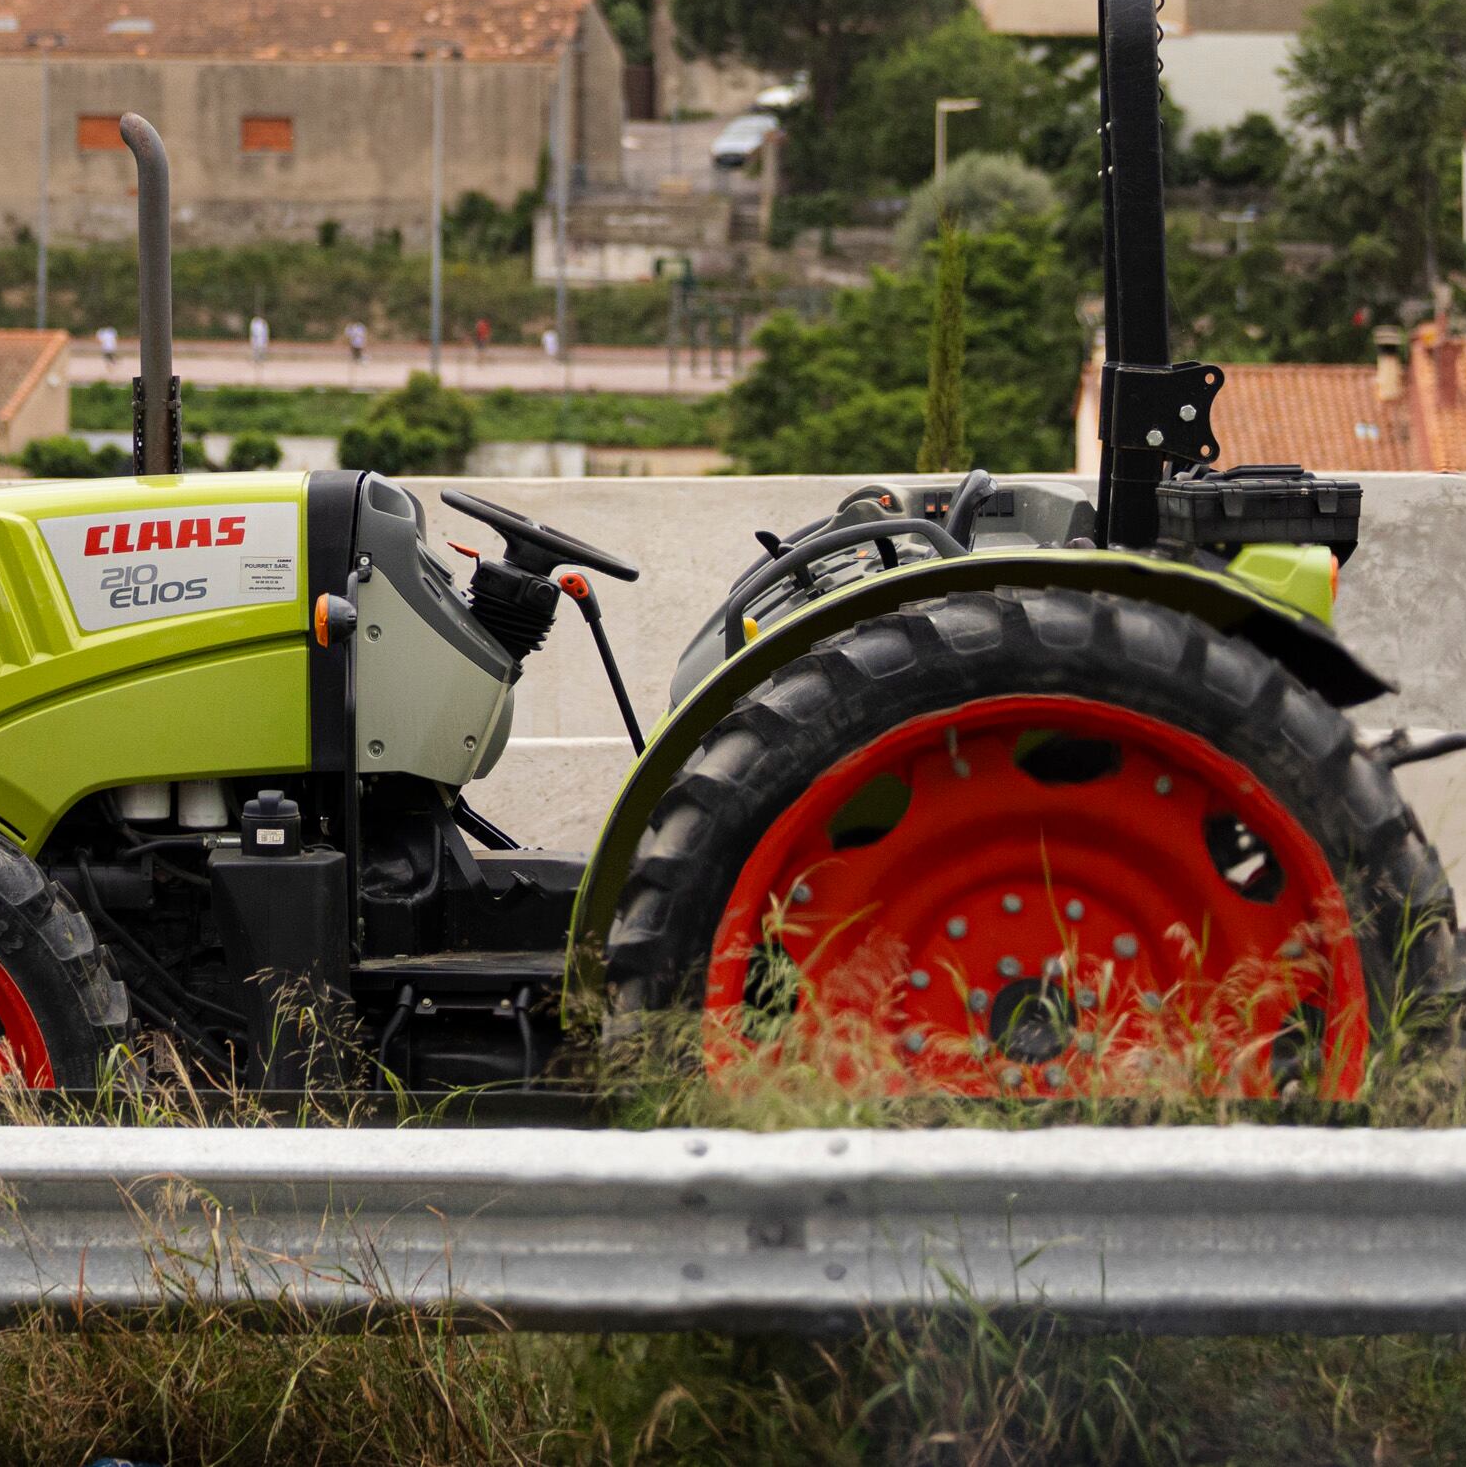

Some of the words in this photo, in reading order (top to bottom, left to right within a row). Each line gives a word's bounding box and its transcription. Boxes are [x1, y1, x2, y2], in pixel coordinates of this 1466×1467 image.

[84, 516, 246, 556] CLAAS
[100, 564, 158, 590] 210
[109, 577, 208, 609] ELIOS
